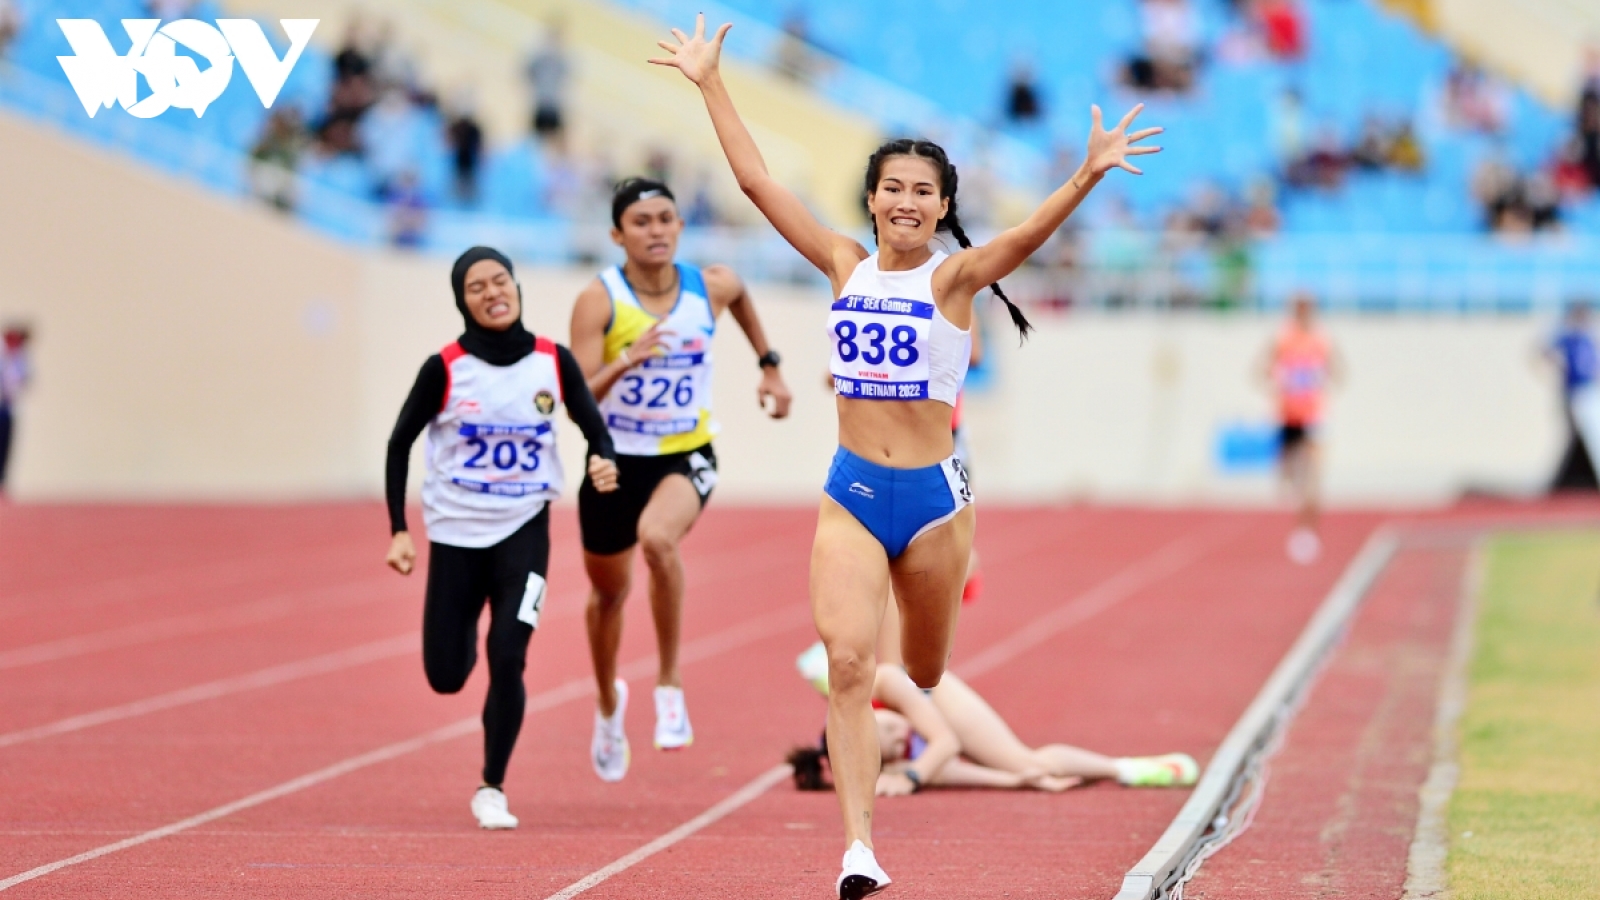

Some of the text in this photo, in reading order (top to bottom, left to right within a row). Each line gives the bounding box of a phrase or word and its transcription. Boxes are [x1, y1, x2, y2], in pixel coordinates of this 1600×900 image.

[863, 297, 880, 311] SEA
[880, 299, 913, 313] Games
[834, 319, 920, 367] 838
[858, 370, 889, 380] VIETNAM
[620, 374, 694, 409] 326
[860, 382, 897, 397] VIETNAM
[898, 383, 921, 397] 2022
[463, 437, 544, 472] 203
